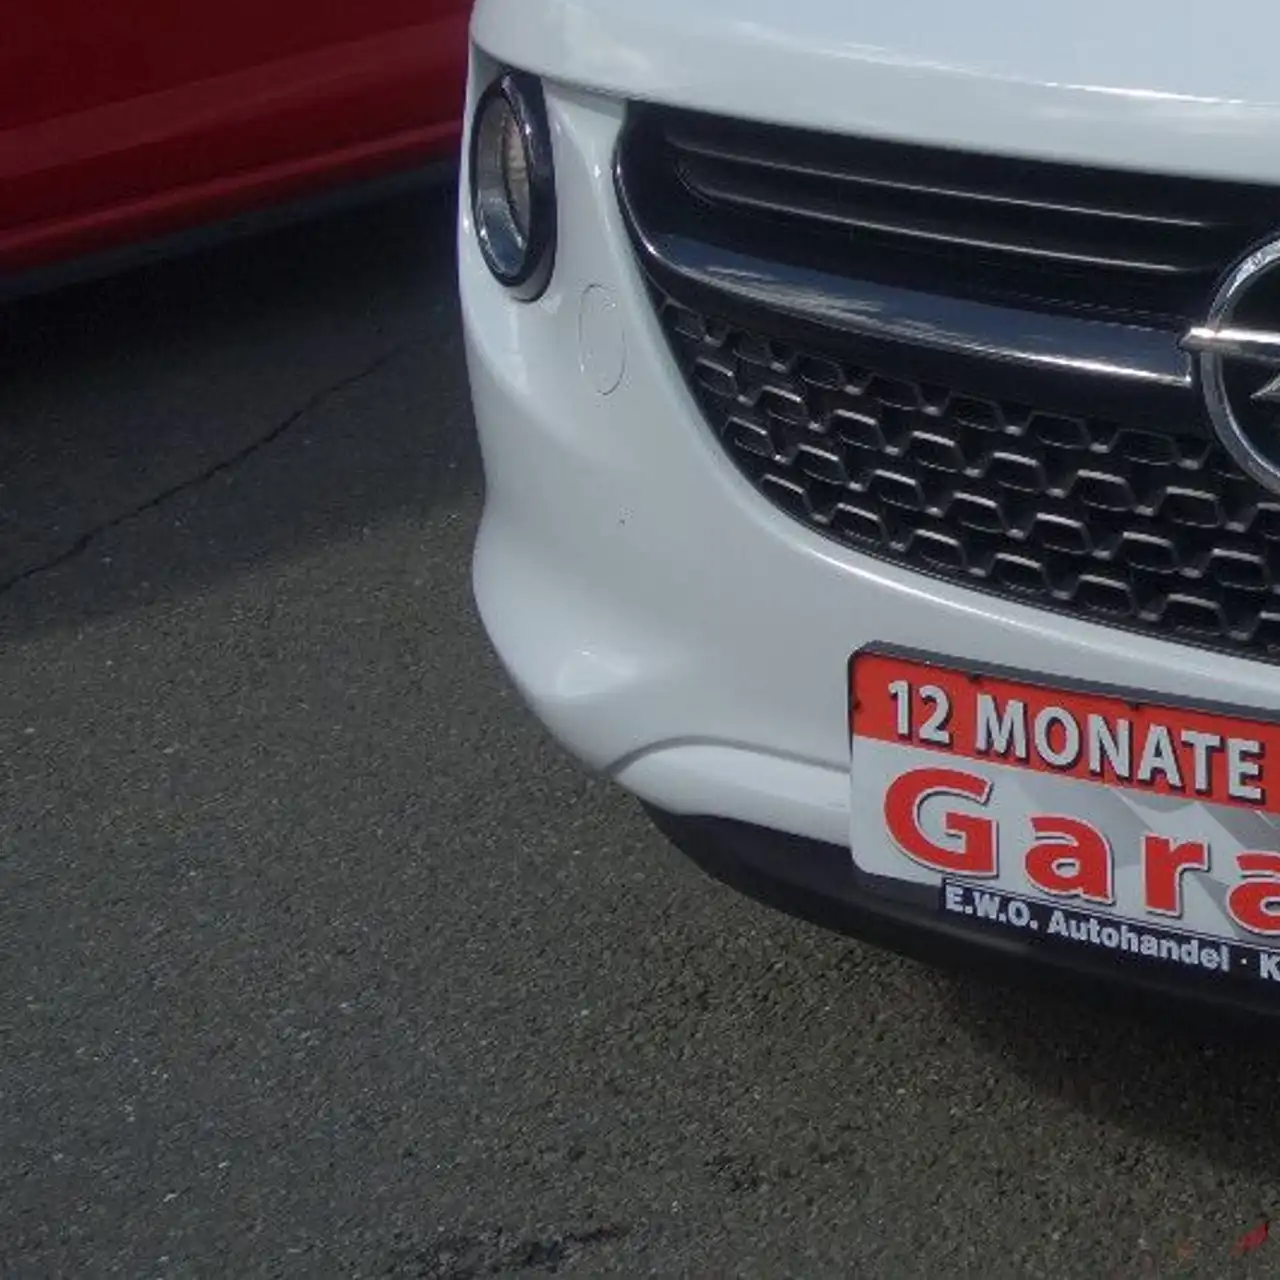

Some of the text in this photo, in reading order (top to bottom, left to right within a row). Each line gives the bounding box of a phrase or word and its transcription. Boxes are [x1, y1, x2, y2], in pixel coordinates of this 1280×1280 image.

[887, 679, 1265, 804] 12 MONATE
[943, 883, 1039, 929] E.W.O.
[1047, 909, 1230, 972] Autohandel
